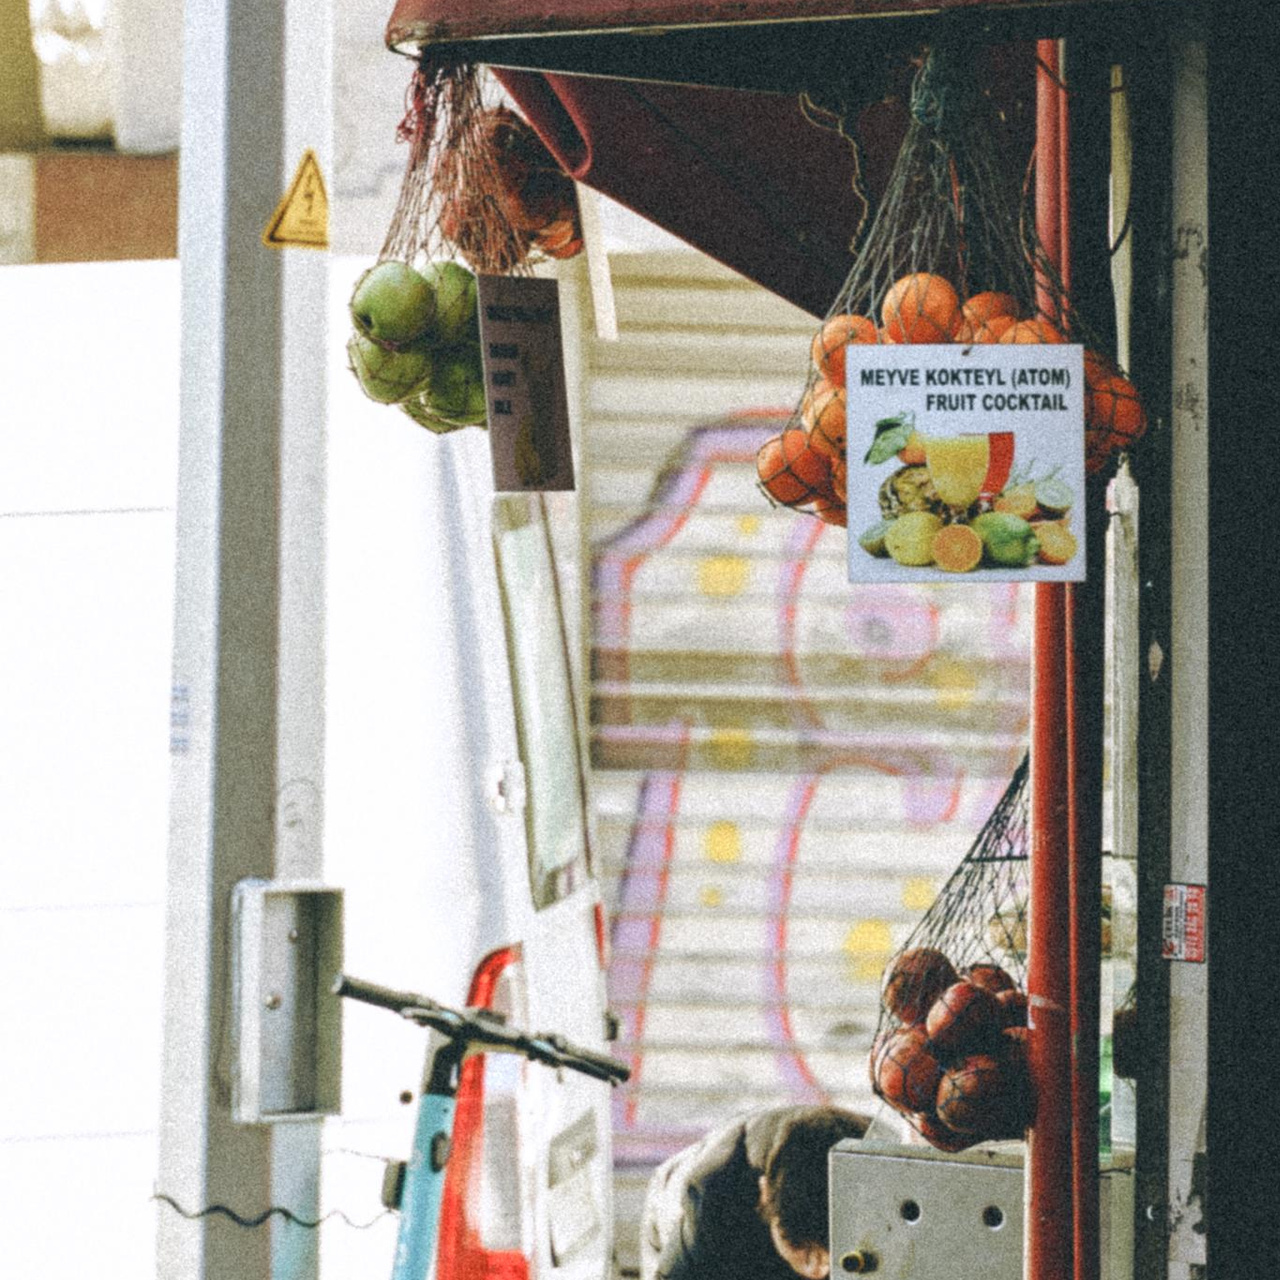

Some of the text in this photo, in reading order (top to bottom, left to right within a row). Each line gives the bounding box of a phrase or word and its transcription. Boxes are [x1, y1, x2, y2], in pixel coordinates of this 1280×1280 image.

[861, 369, 1071, 389] MEYVE KOKTEYL (ATOM)
[926, 394, 1068, 412] FRUIT COCKTAIL
